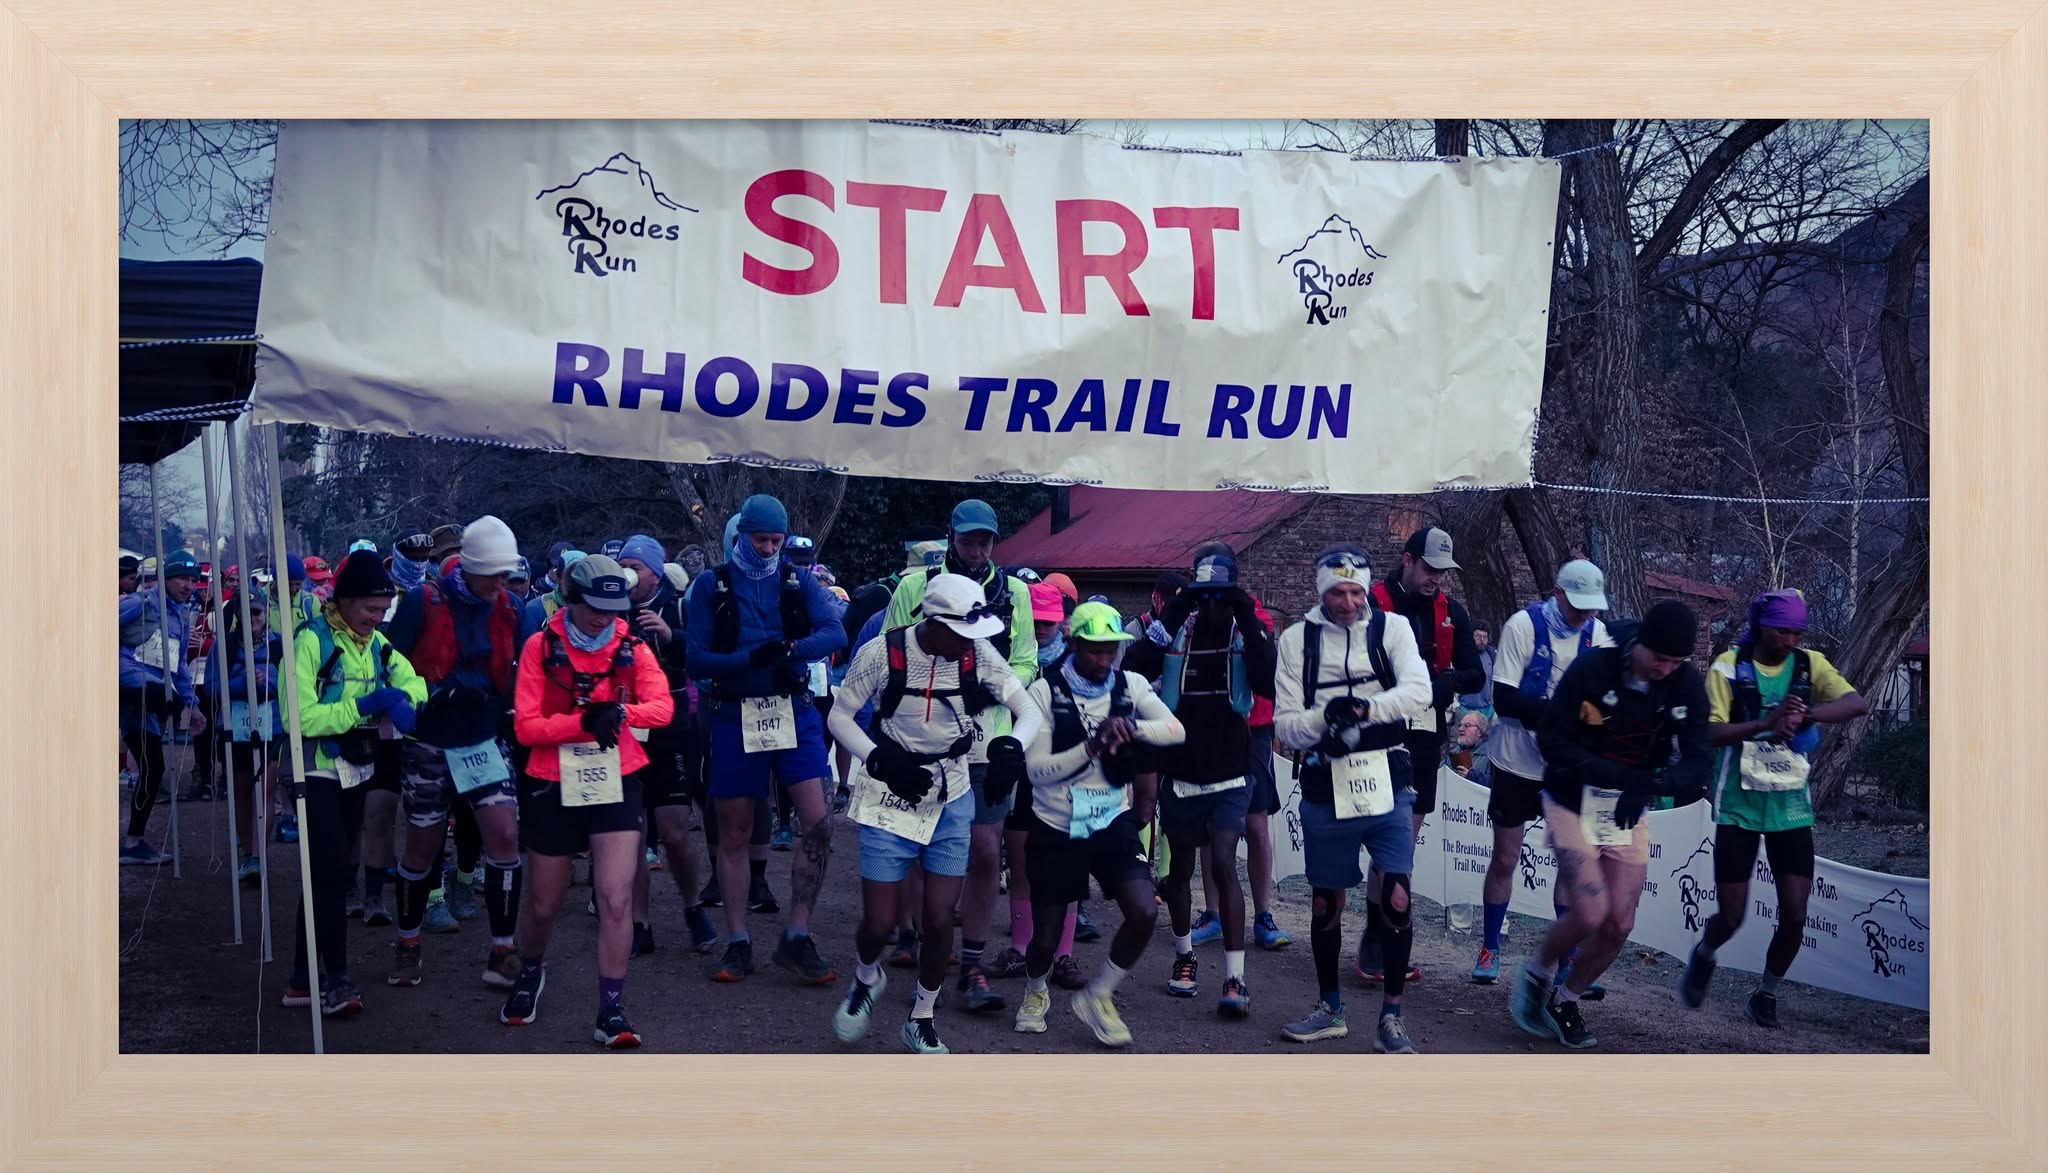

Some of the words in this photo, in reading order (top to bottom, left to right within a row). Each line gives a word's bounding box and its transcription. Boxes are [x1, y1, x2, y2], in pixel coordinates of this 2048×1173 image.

[556, 198, 680, 241] Rhodes
[568, 234, 637, 277] Run
[742, 168, 1240, 320] START
[1293, 258, 1374, 296] Rhodes
[1304, 290, 1348, 326] Run
[552, 342, 930, 429] RHODES
[958, 376, 1181, 437] TRAIL
[1206, 383, 1353, 440] RUN
[241, 716, 264, 727] 102
[756, 717, 781, 732] 1547
[462, 750, 488, 769] 1182
[576, 766, 608, 783] 1555
[1348, 777, 1377, 794] 1516
[879, 791, 913, 812] 1543
[1442, 802, 1468, 824] Rhodes
[1469, 807, 1485, 828] Trail
[1442, 838, 1455, 853] The
[1455, 840, 1493, 859] Breathtaki
[1519, 842, 1558, 869] Rhode
[1648, 841, 1662, 860] un
[1454, 857, 1470, 873] Trail
[1471, 859, 1486, 875] Run
[1521, 864, 1548, 890] Run
[1678, 874, 1717, 904] Rhod
[1755, 899, 1773, 919] The
[1861, 919, 1925, 953] Rhodes
[1869, 944, 1906, 978] Run
